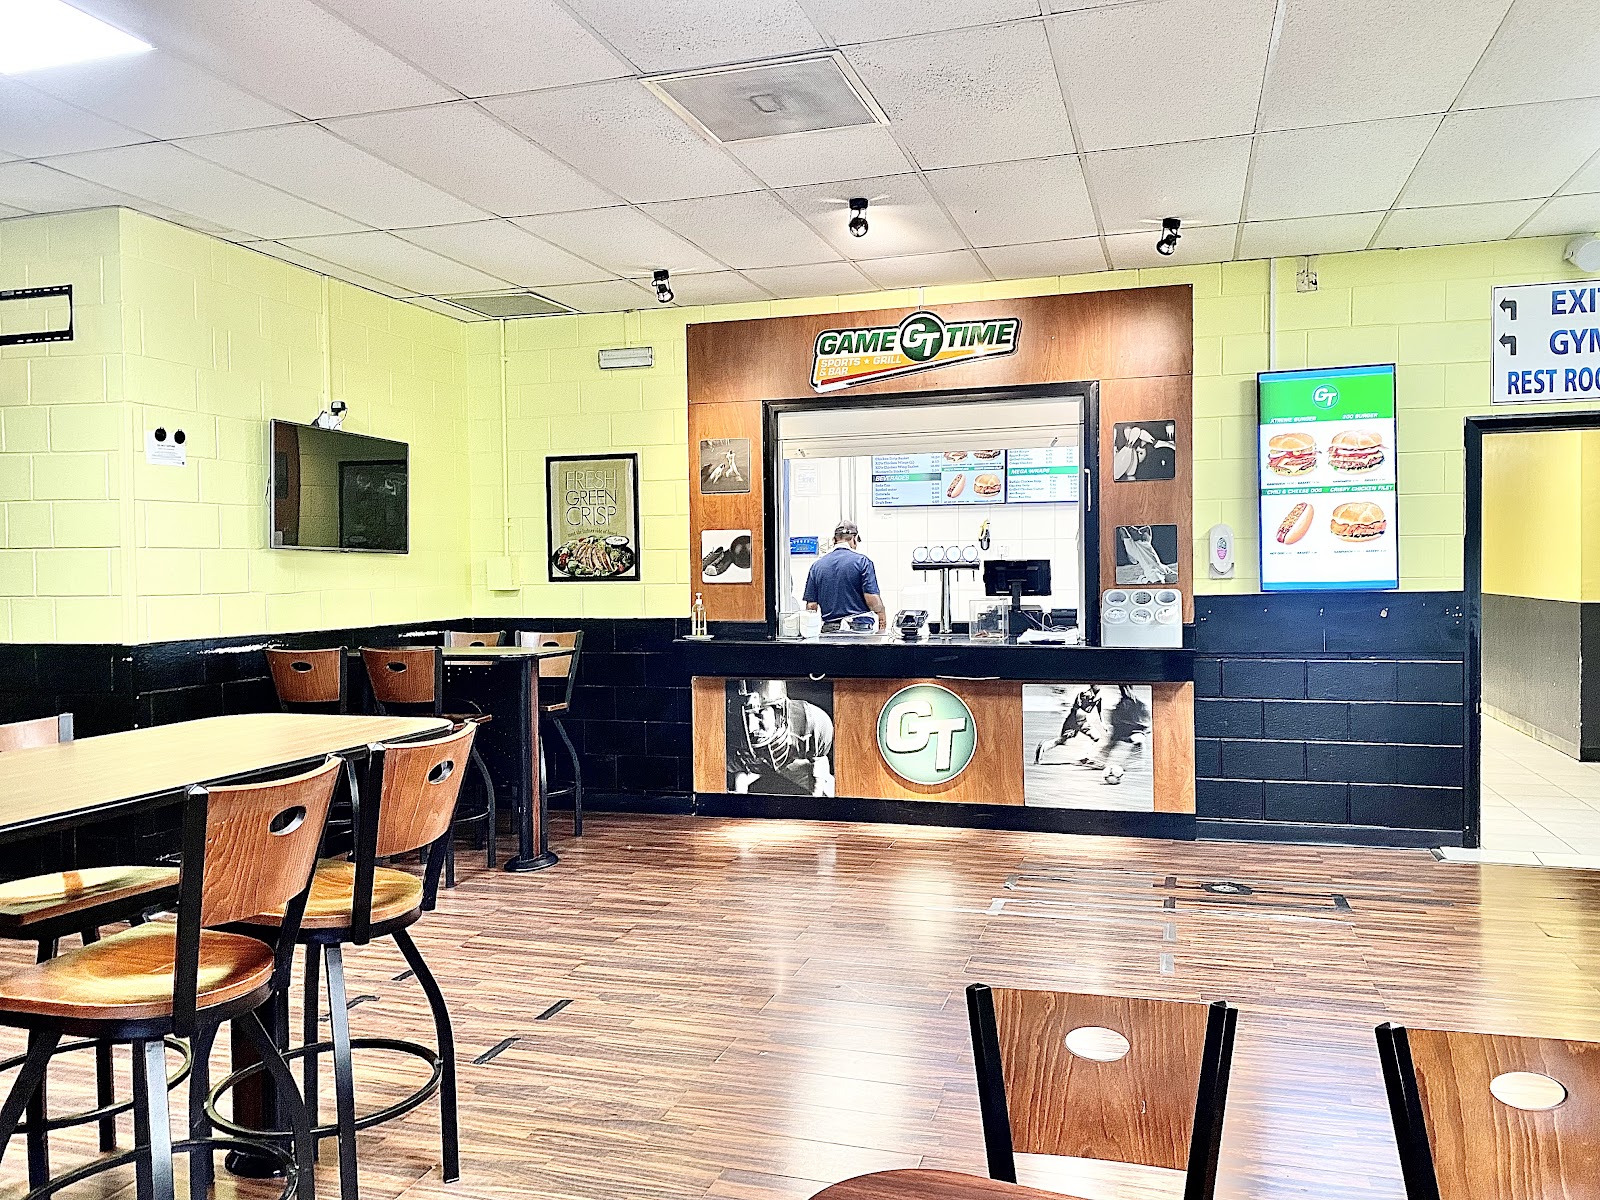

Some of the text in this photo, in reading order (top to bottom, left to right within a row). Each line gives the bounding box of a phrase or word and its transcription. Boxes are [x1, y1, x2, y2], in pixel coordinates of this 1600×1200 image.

[1551, 288, 1600, 315] EXI
[819, 322, 1014, 357] GAME GT TIME
[819, 366, 848, 376] & BAR
[820, 355, 902, 368] SPORTS GRILL
[1508, 369, 1557, 394] REST
[1314, 387, 1338, 407] GT
[566, 470, 617, 490] FRESH
[565, 490, 617, 506] GREEN
[566, 506, 617, 526] CRISP
[886, 700, 967, 773] GT
